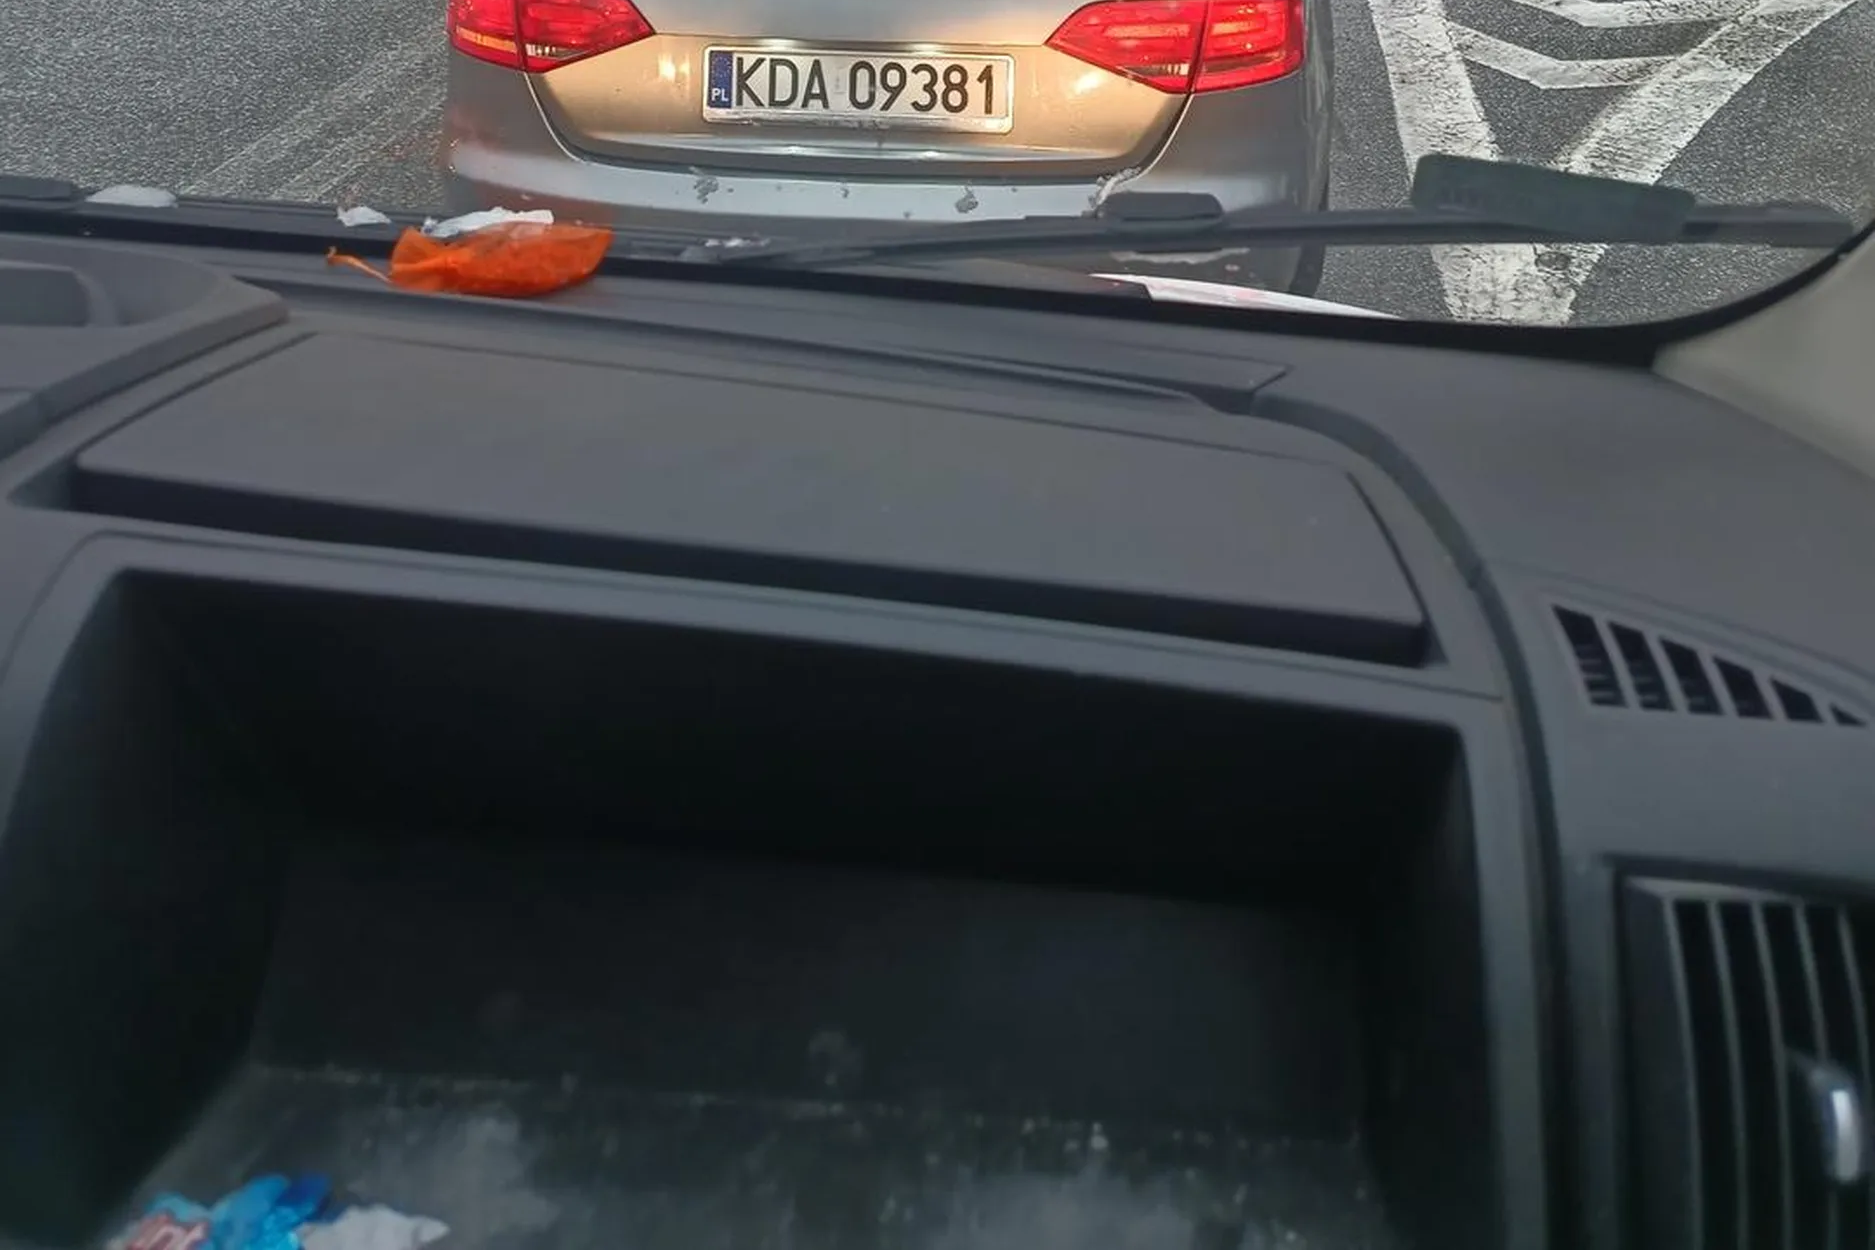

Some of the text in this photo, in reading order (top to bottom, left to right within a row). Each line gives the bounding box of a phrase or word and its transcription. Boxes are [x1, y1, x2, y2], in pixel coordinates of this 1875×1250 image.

[711, 87, 729, 101] PL
[736, 57, 994, 115] KDA 09381
